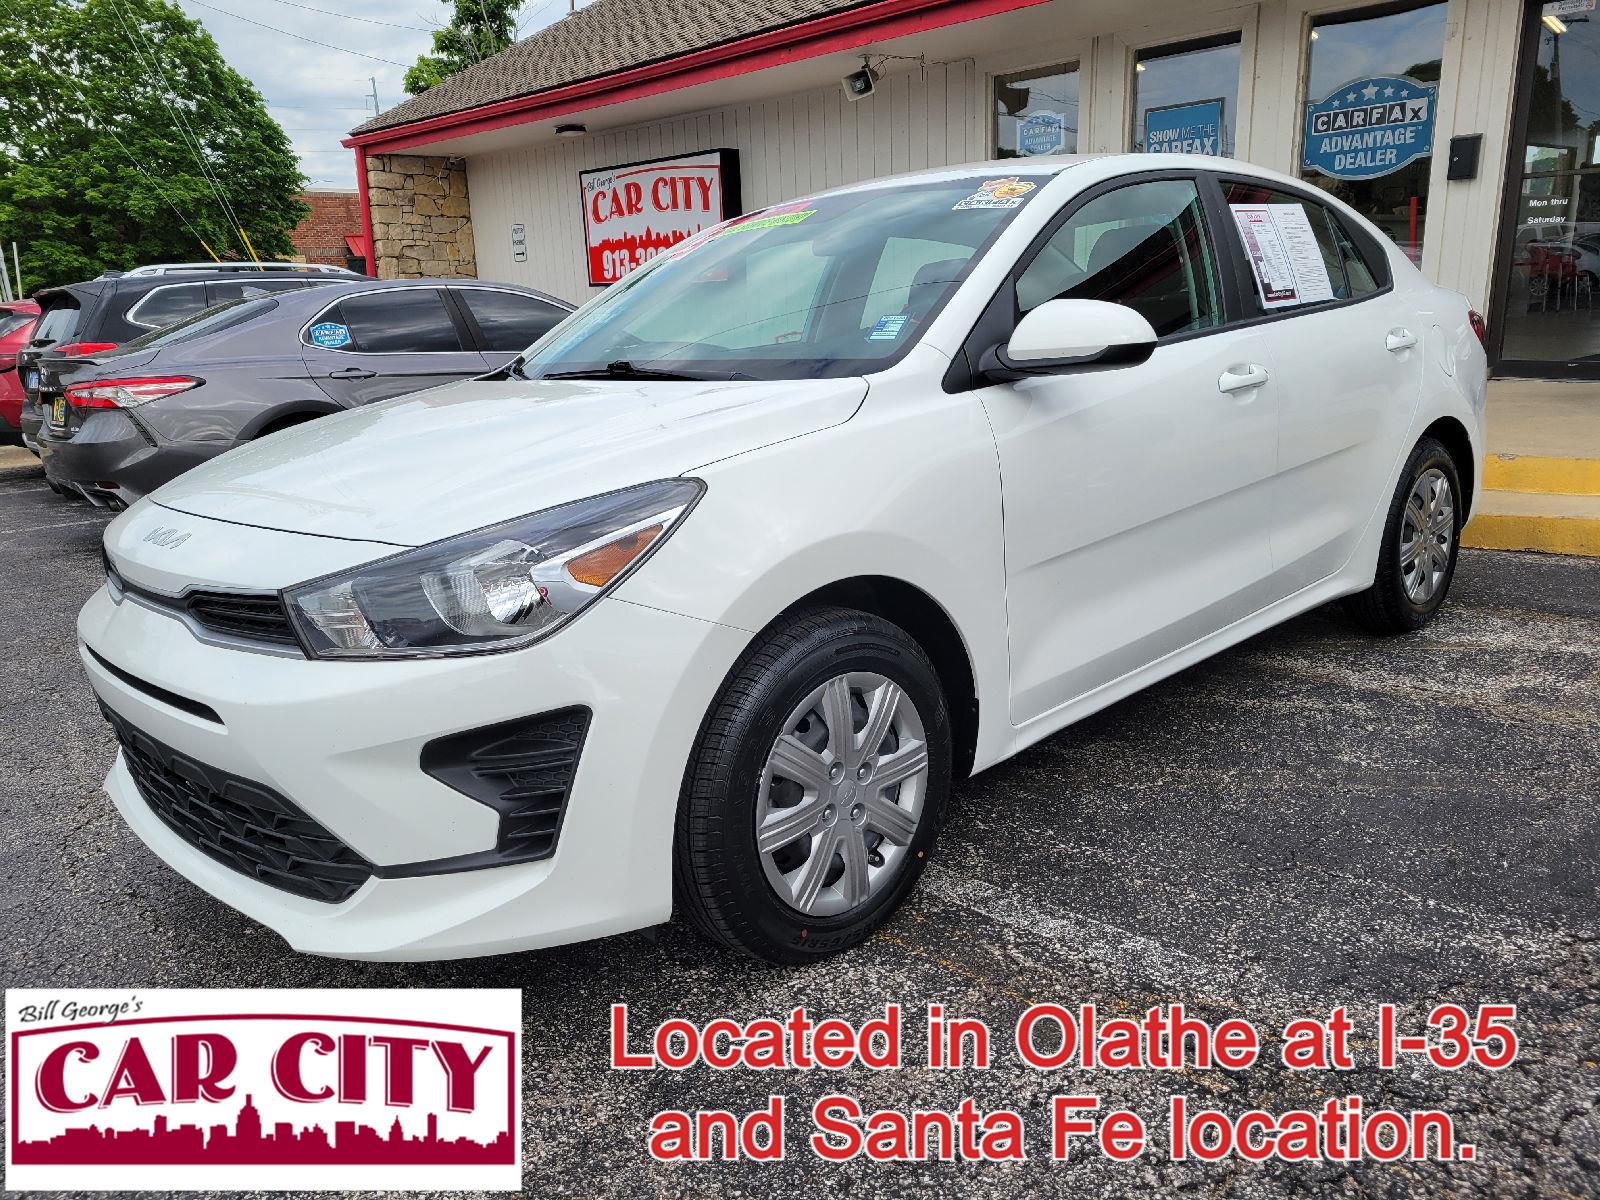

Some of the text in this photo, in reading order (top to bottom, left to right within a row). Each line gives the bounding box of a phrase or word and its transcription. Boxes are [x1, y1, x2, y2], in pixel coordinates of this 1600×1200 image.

[1314, 102, 1426, 134] CARFAX
[1149, 123, 1216, 143] SHOW ME THE
[1334, 149, 1398, 171] DEALER
[591, 176, 714, 225] CAR CITY
[1529, 198, 1569, 208] Mon thru
[1527, 215, 1566, 225] Saturday
